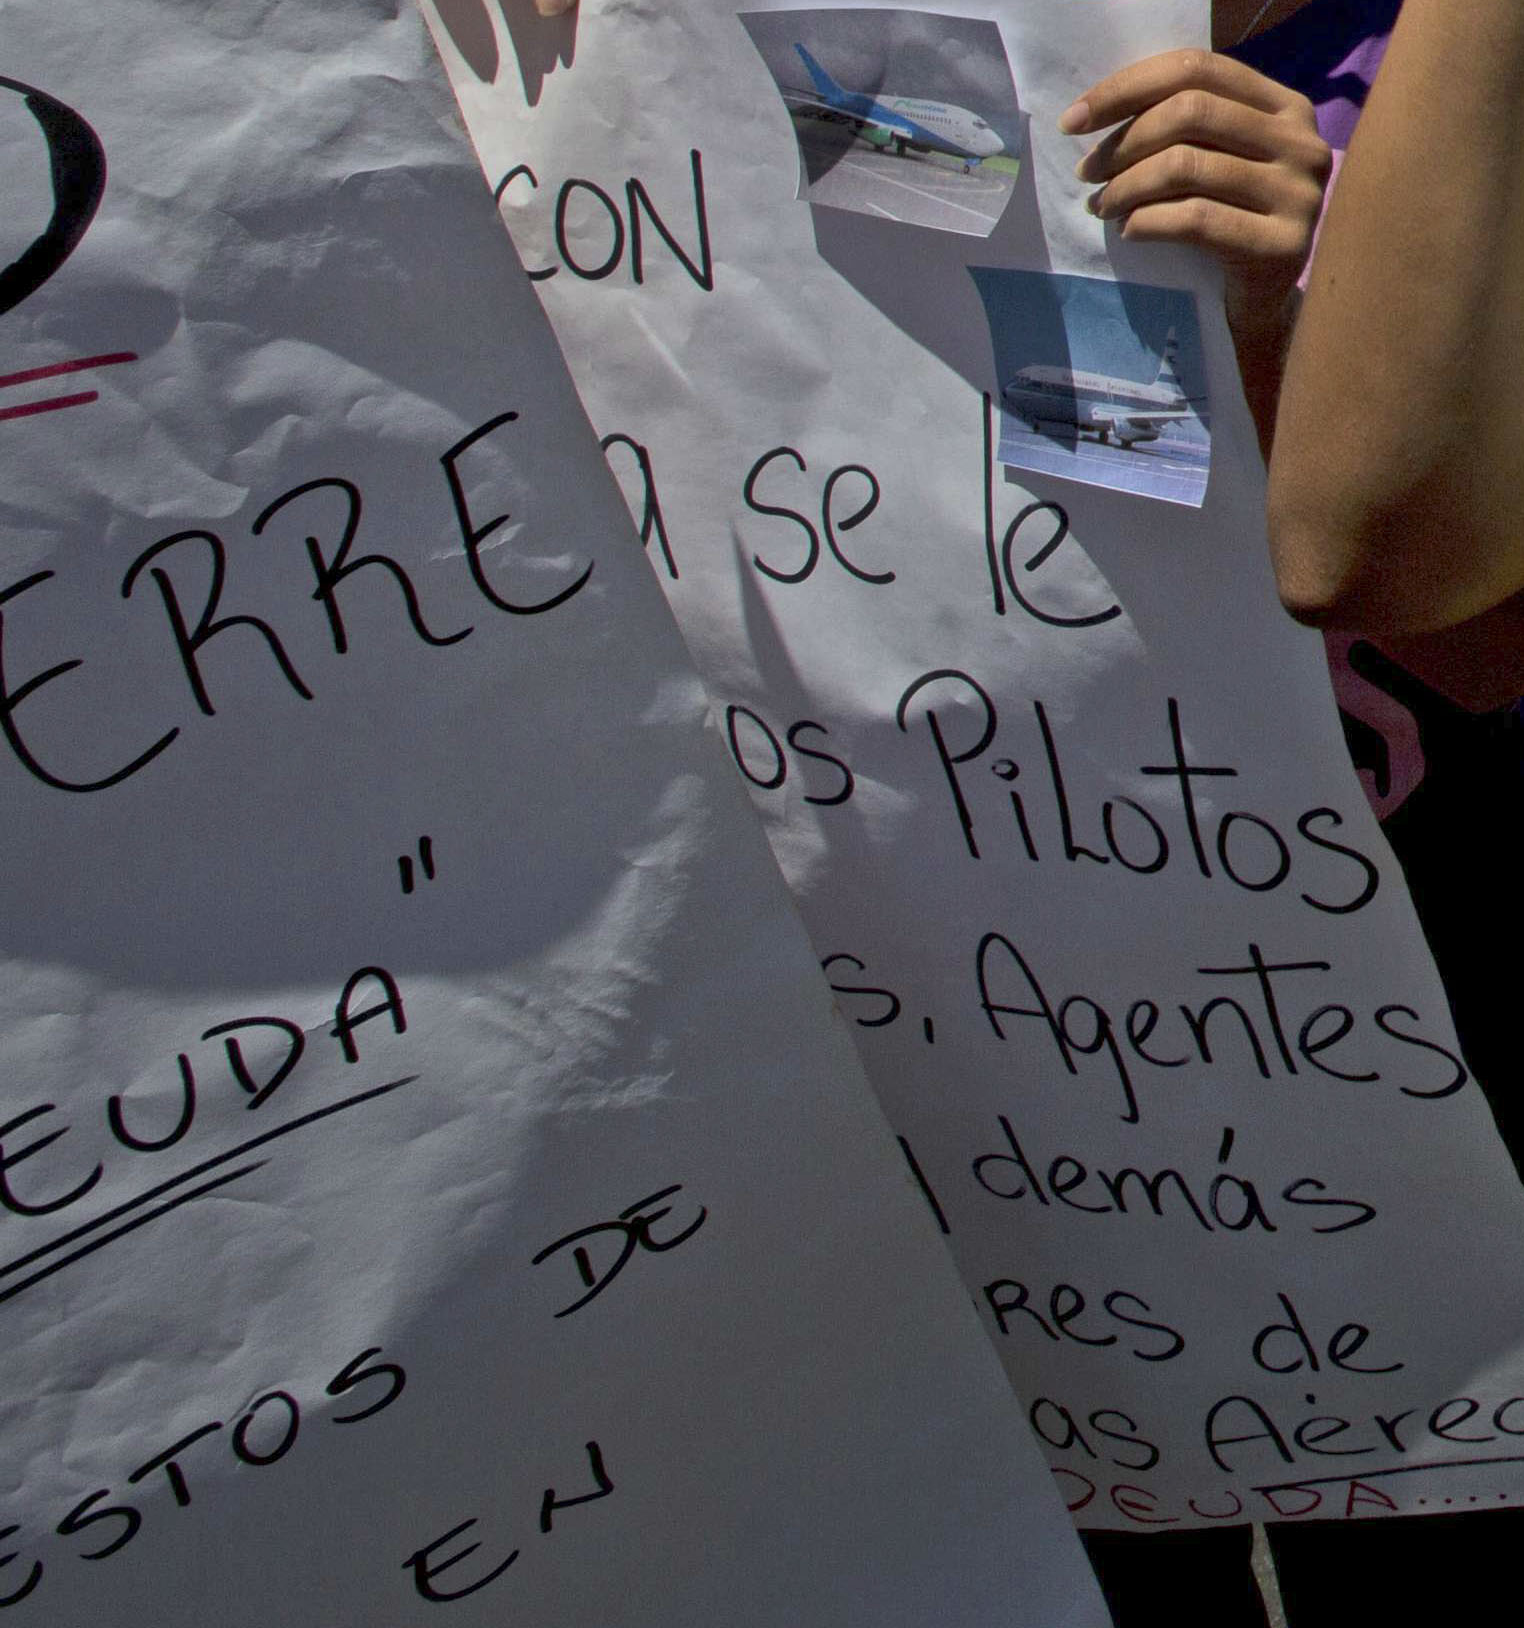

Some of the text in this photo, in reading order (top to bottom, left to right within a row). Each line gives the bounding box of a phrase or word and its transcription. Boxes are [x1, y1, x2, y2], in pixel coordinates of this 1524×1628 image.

[742, 444, 896, 586] se
[982, 392, 1123, 628] le
[974, 932, 1469, 1125] Agentes
[971, 1114, 1378, 1236] demás
[531, 1184, 707, 1318] DE
[1252, 1292, 1405, 1373] de
